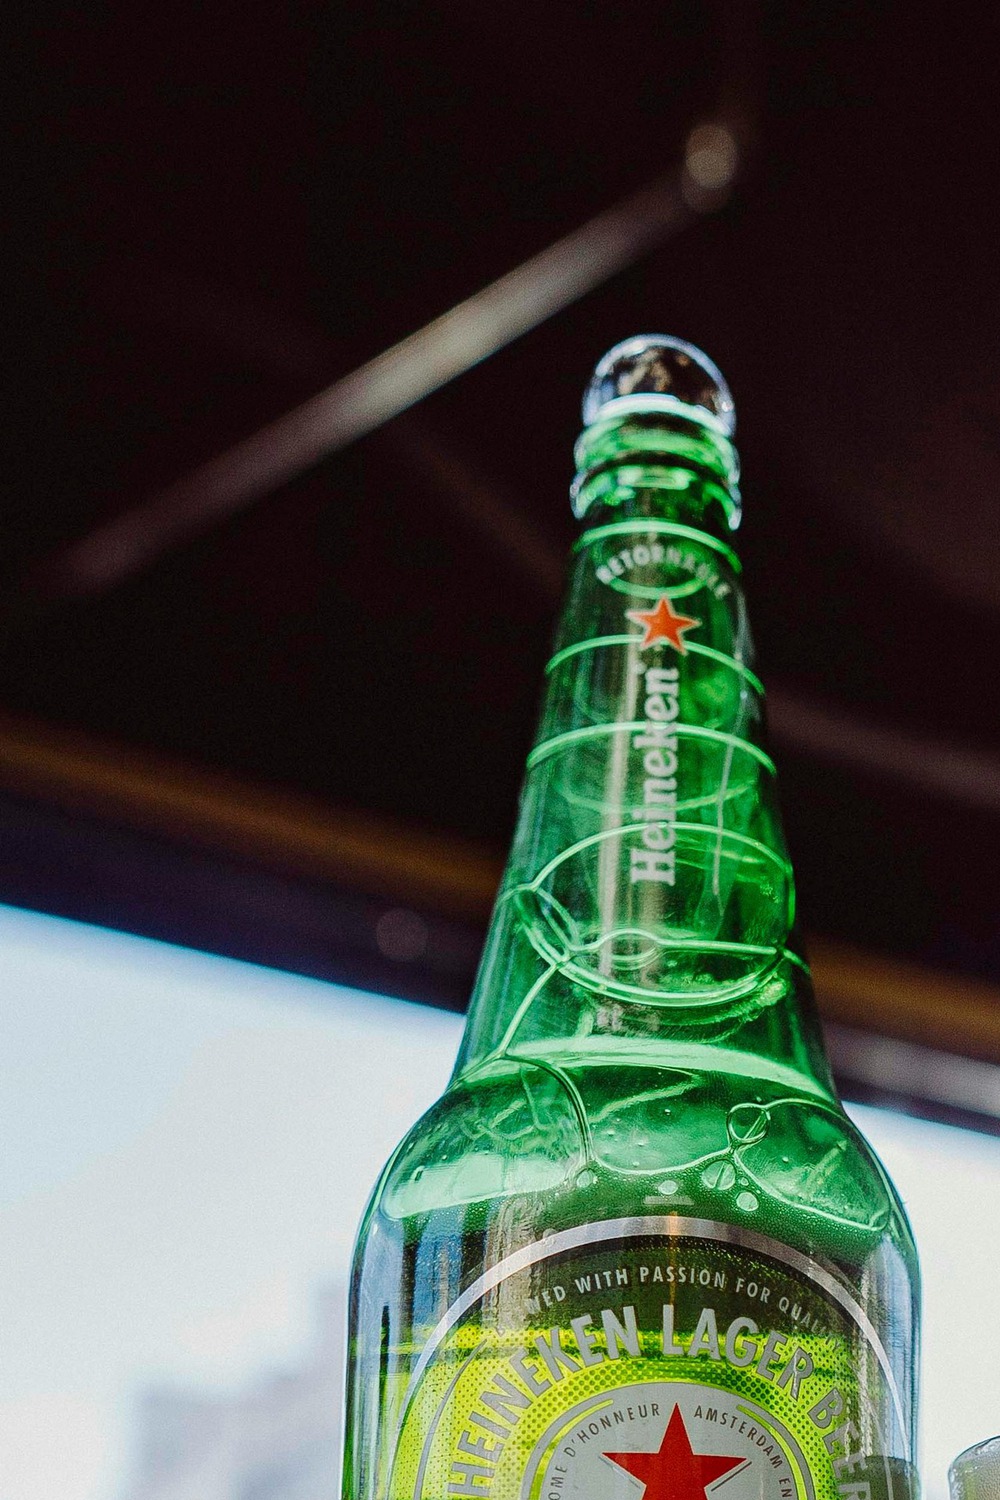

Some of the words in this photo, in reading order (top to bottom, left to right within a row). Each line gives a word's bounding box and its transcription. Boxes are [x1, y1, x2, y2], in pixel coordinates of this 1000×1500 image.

[630, 667, 679, 886] Heineken
[574, 1268, 628, 1294] WITH
[639, 1265, 725, 1289] PASSION
[735, 1277, 771, 1303] FOR
[447, 1305, 641, 1497] HEINEKEN
[662, 1304, 814, 1401] LAGER
[563, 1403, 660, 1457] D'HONNEUR
[693, 1405, 784, 1469] AMSTERDAM
[778, 1477, 793, 1498] EN
